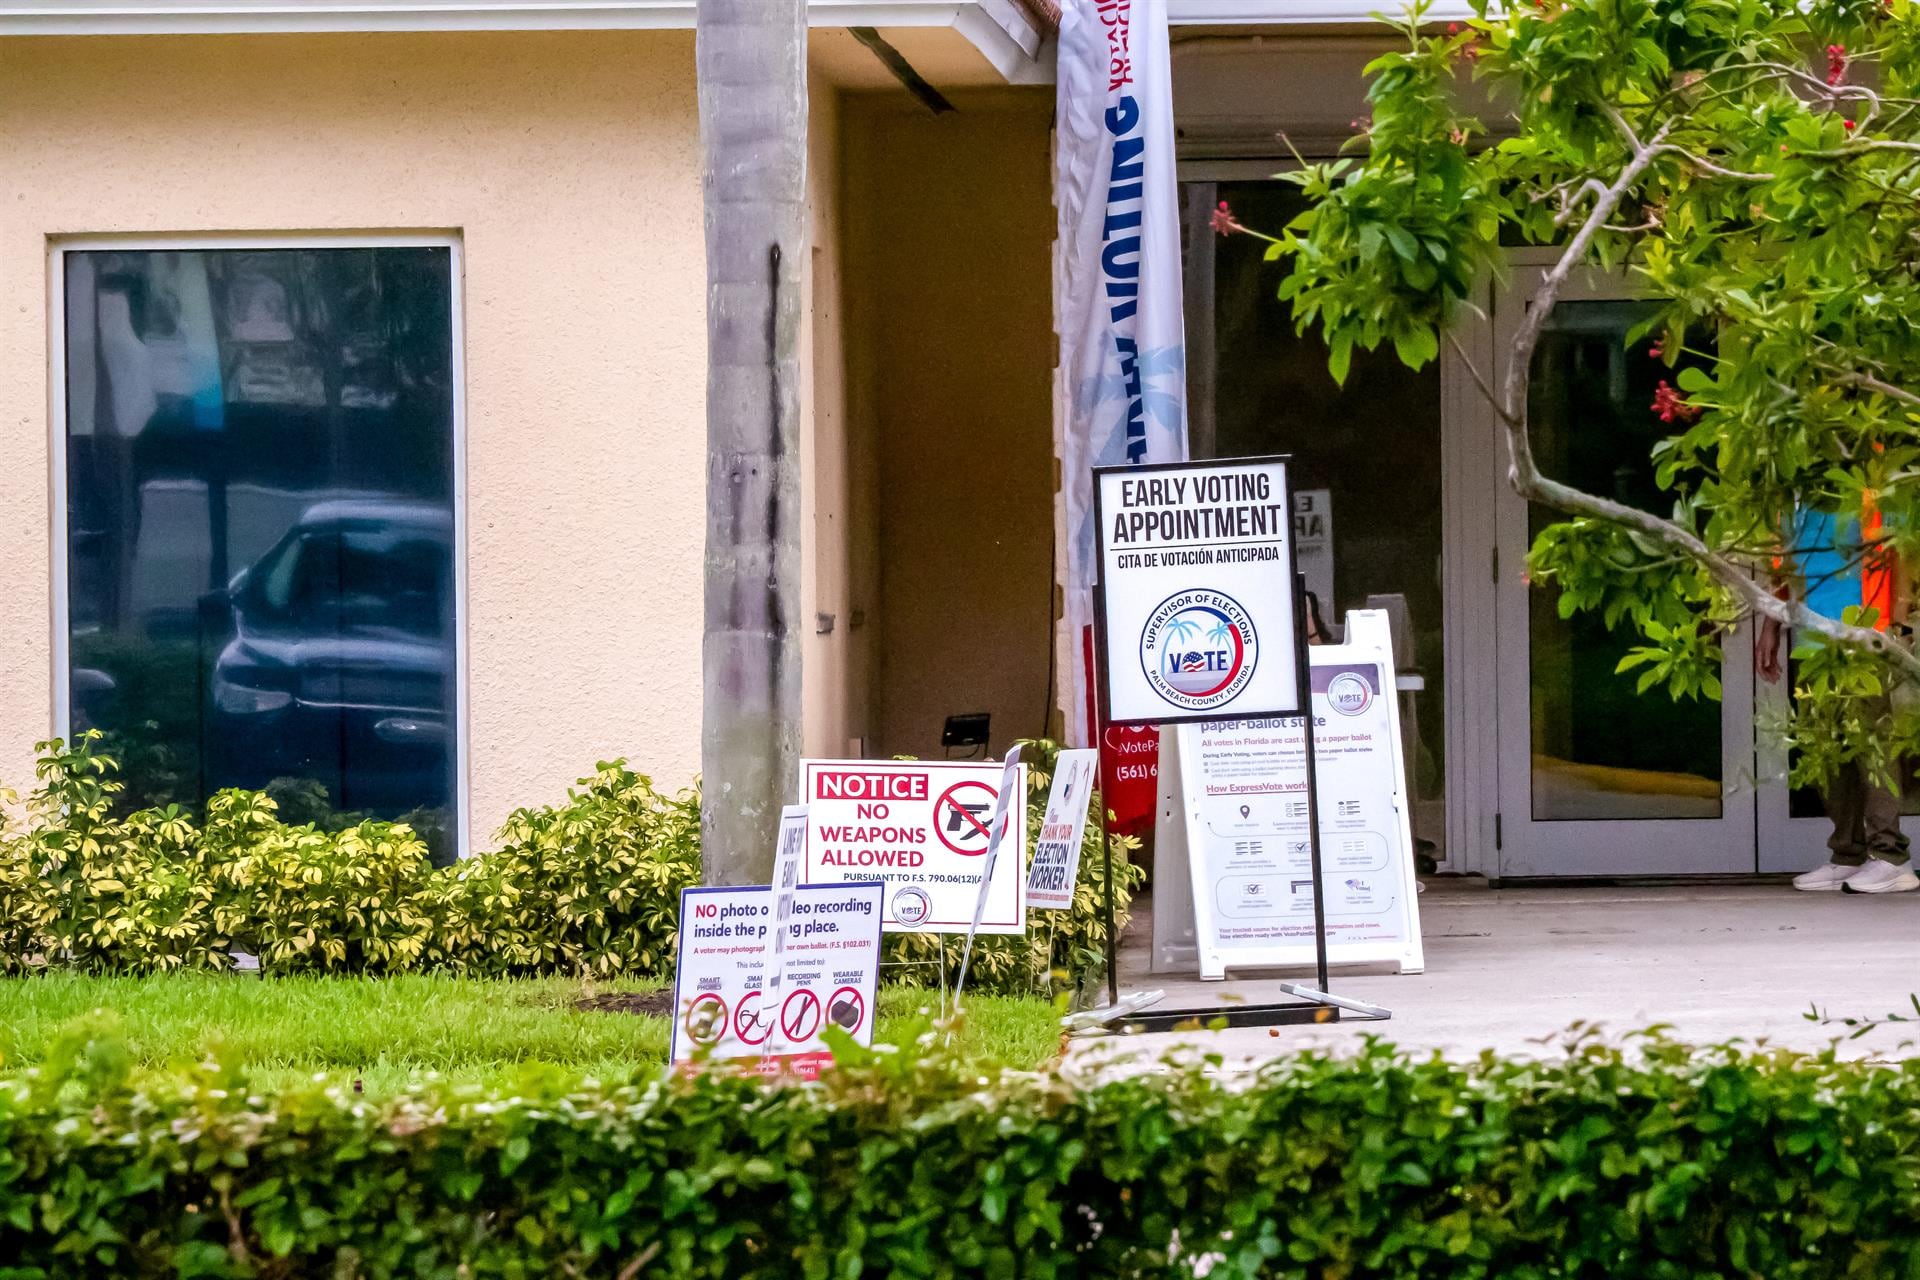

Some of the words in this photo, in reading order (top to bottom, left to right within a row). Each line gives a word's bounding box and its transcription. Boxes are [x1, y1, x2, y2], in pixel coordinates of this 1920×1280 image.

[1122, 477, 1187, 508] EARLY
[1193, 473, 1270, 503] VOTING
[1114, 504, 1281, 543] APPOINTMENT
[1118, 554, 1142, 569] CITA
[1144, 553, 1158, 568] DE
[1161, 548, 1213, 567] VOTACIÓN
[1216, 546, 1279, 565] ANTICIPADA
[1145, 596, 1192, 650] SUPERVISOR
[1195, 594, 1210, 604] OF
[1212, 597, 1252, 645] ELECTIONS
[1149, 669, 1166, 691] PALM
[1165, 688, 1191, 706] BEACH
[1226, 664, 1251, 696] FLORIDA
[1200, 719, 1287, 733] paper-ballot
[1291, 716, 1326, 728] stte
[1214, 738, 1234, 747] votes
[1235, 738, 1242, 746] in
[1244, 737, 1270, 746] Florida
[1284, 736, 1300, 744] cast
[1328, 735, 1349, 743] paper
[1117, 764, 1148, 782] (561)
[822, 774, 925, 798] NOTICE
[1206, 784, 1228, 794] How
[1229, 782, 1284, 794] ExpressVote
[1285, 782, 1308, 790] work
[857, 804, 889, 819] NO
[820, 826, 926, 843] WEAPONS
[820, 850, 924, 867] ALLOWED
[1034, 842, 1070, 864] ELECTION
[844, 873, 895, 882] PURSUANT
[897, 874, 910, 882] TO
[912, 874, 927, 882] F.S.
[1028, 865, 1065, 890] WORKER
[696, 904, 716, 918] NO
[720, 902, 758, 920] photo
[760, 906, 769, 916] o
[814, 898, 872, 916] recording
[694, 924, 733, 938] inside
[734, 922, 755, 936] the
[804, 920, 839, 937] place.
[717, 947, 730, 955] may
[843, 940, 872, 950] §102.031)
[797, 958, 816, 966] limited
[788, 972, 821, 980] RECORDING
[832, 970, 864, 978] WEARABLE
[833, 977, 862, 985] CAMERAS
